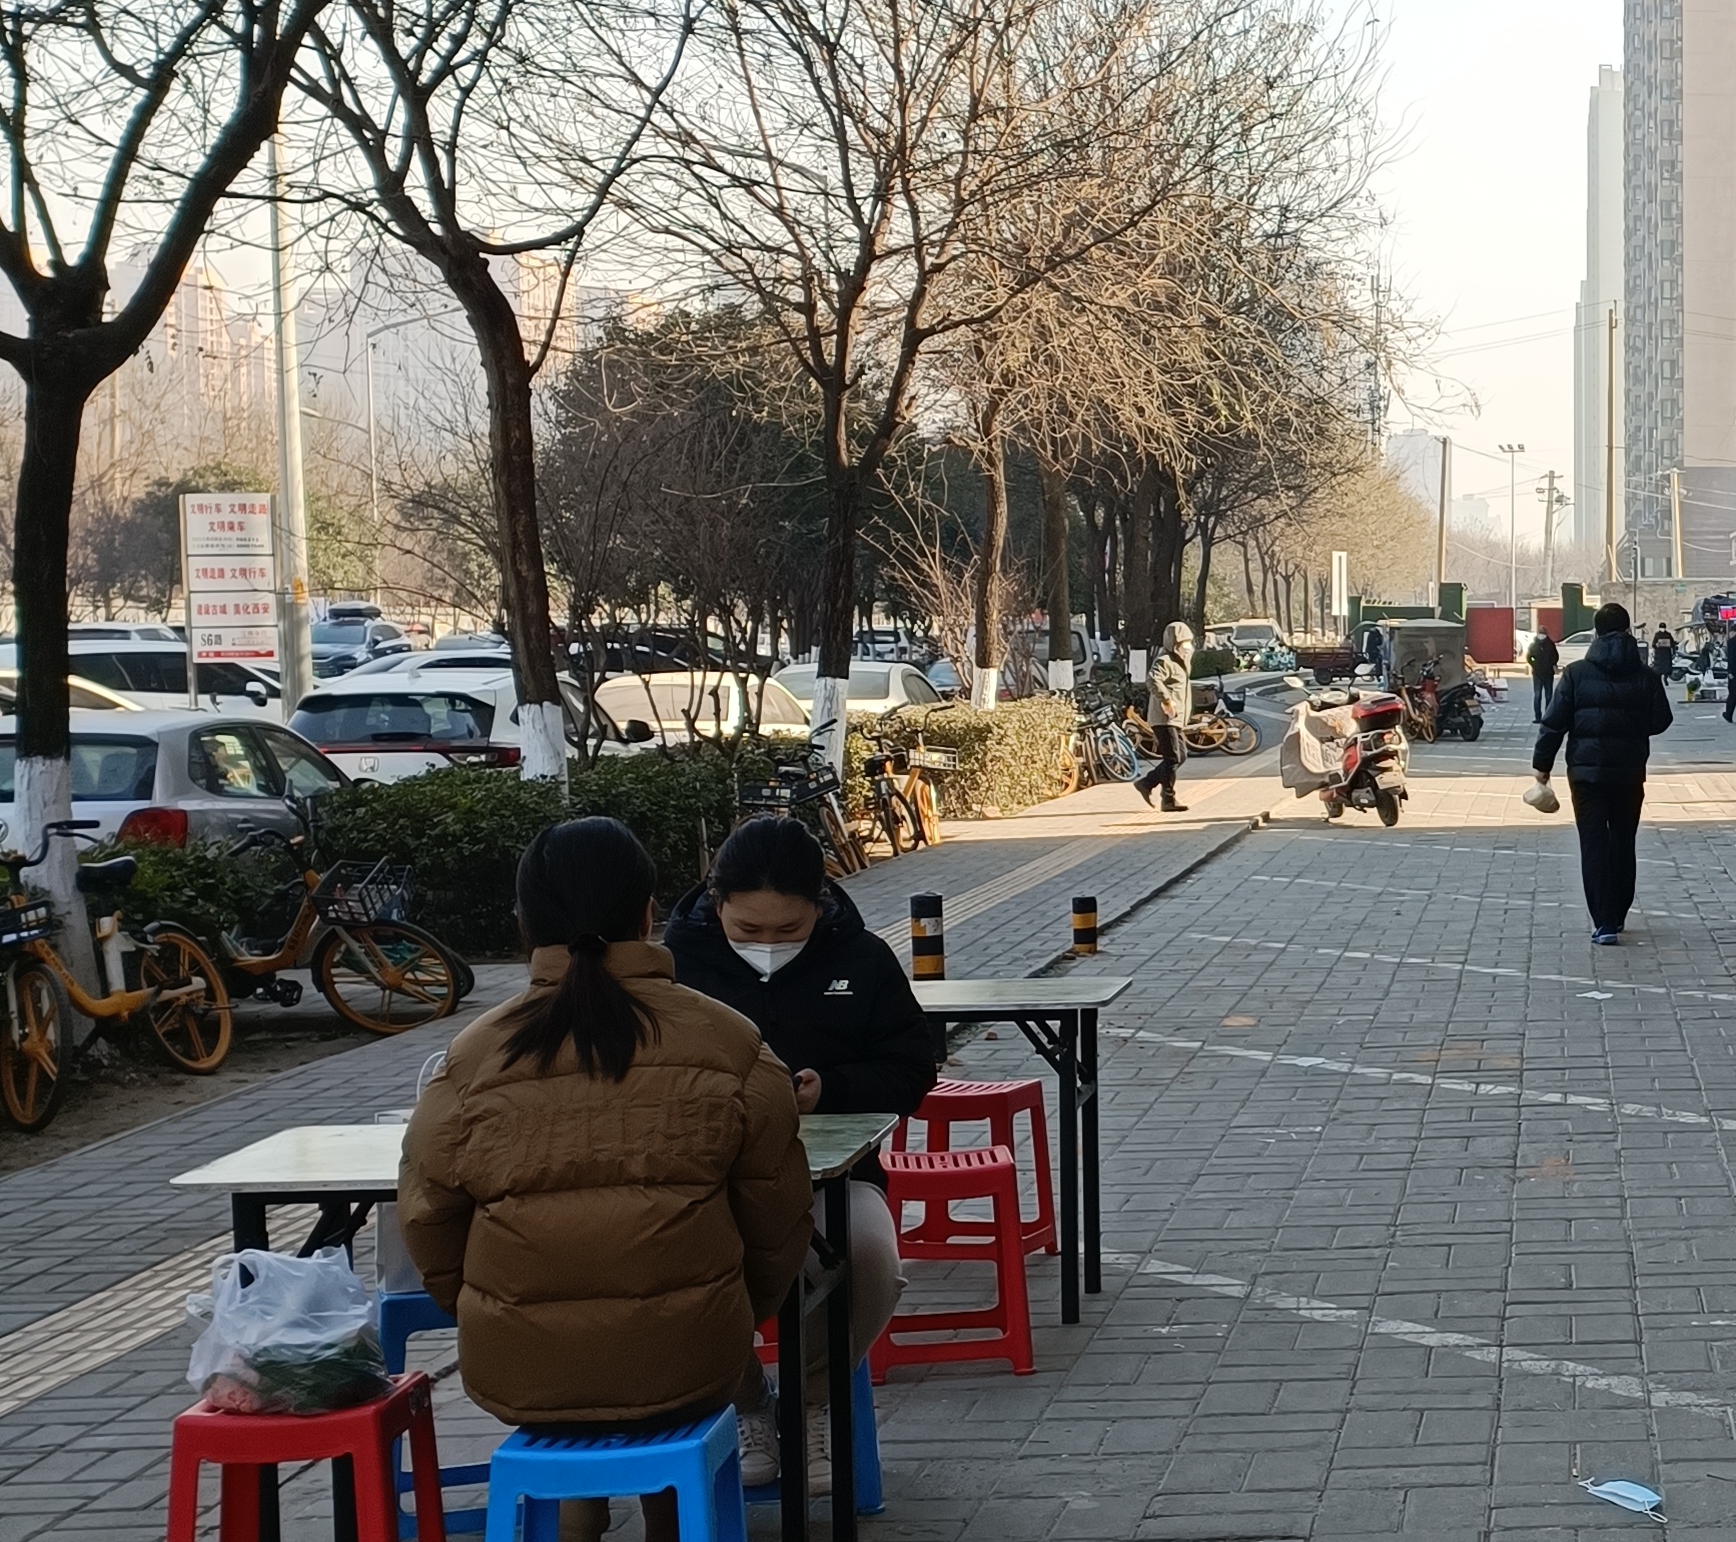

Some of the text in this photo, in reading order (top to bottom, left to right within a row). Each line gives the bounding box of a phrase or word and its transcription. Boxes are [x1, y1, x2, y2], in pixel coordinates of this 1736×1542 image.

[190, 503, 267, 515] 文明行车 文明走路
[230, 567, 267, 579] 文明行车
[827, 979, 850, 991] NB
